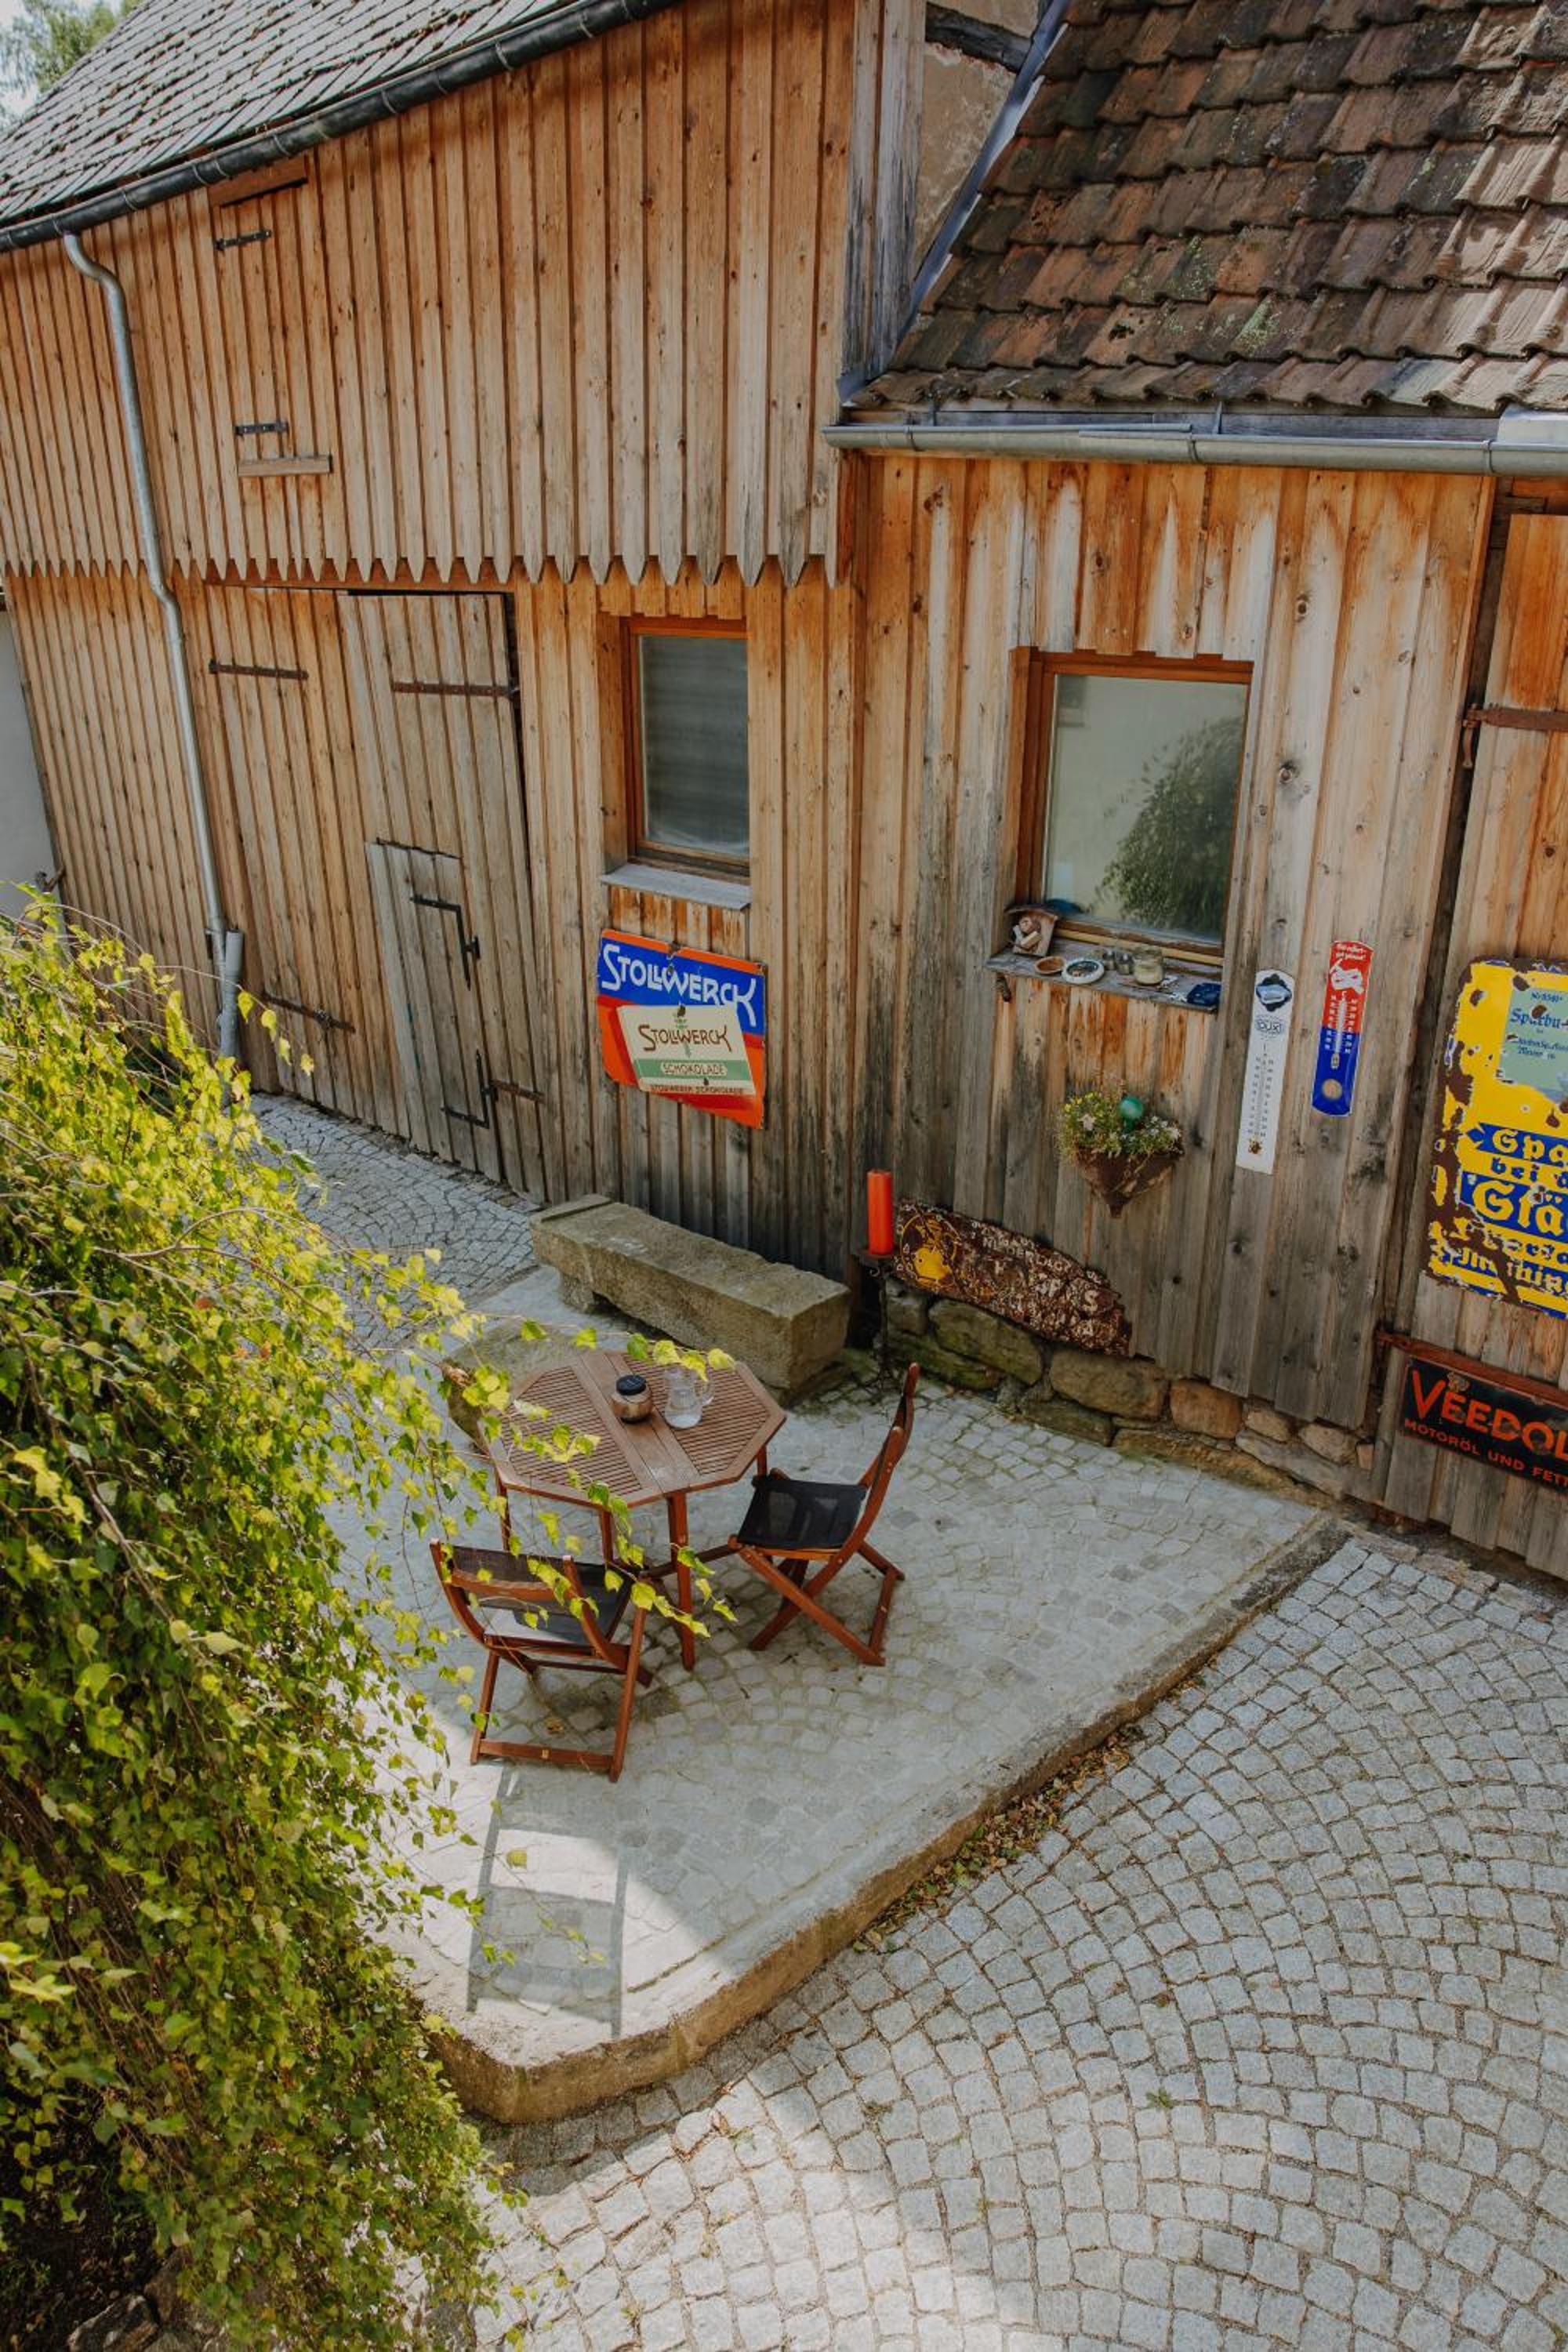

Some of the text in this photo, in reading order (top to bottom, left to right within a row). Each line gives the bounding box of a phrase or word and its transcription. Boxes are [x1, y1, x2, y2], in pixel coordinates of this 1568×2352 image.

[601, 943, 757, 1028] STOLLWERCK
[638, 1024, 732, 1053] STOLLWERCK
[1413, 1370, 1568, 1461] VEEDOL
[1487, 1450, 1526, 1471] UND
